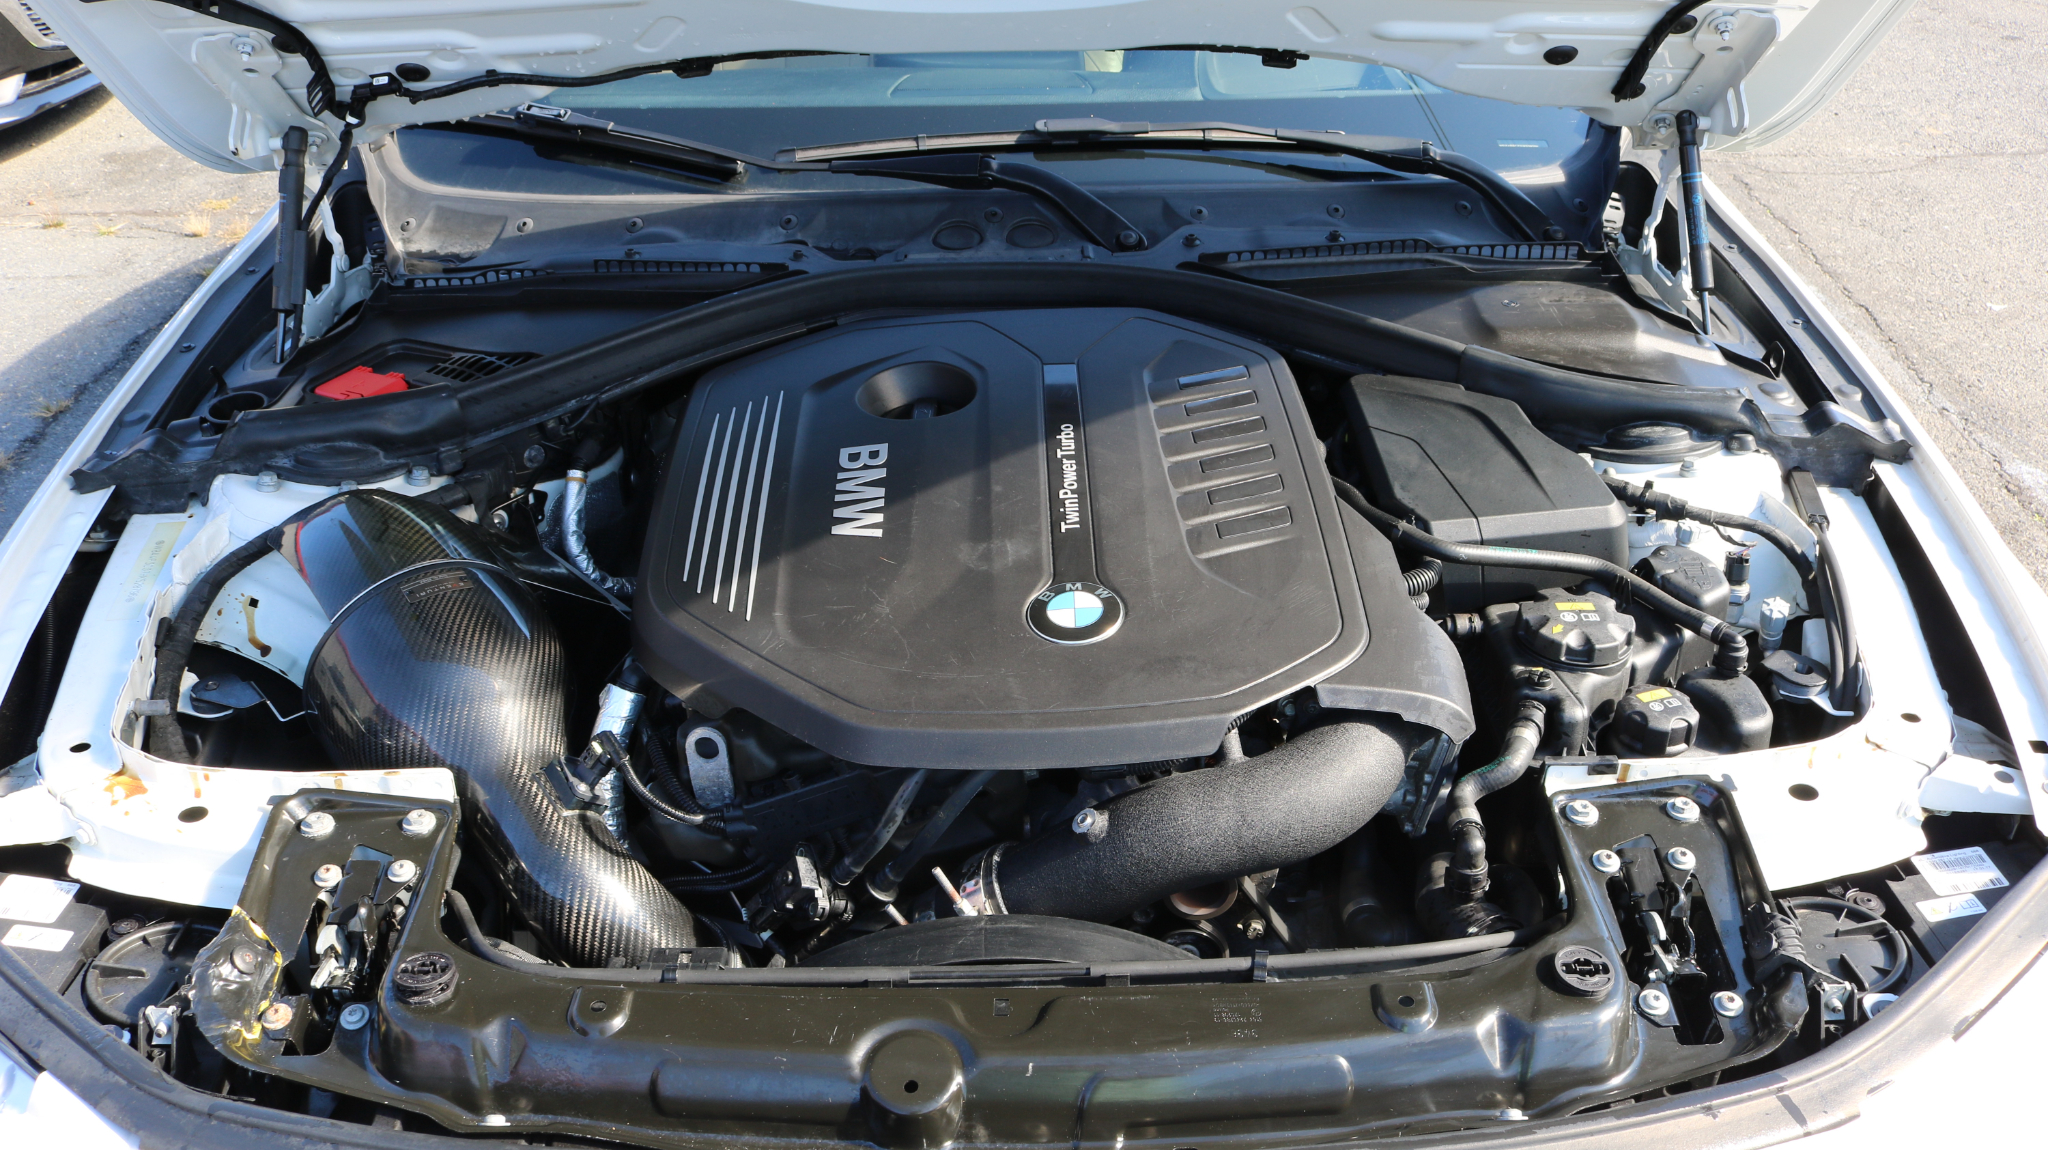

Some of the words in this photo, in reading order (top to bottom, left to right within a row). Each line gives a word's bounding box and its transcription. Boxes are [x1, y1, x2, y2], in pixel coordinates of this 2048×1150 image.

[1056, 423, 1076, 458] Turbo
[831, 443, 889, 538] BMW
[1058, 458, 1081, 533] TwinPower
[1038, 583, 1113, 602] BMW
